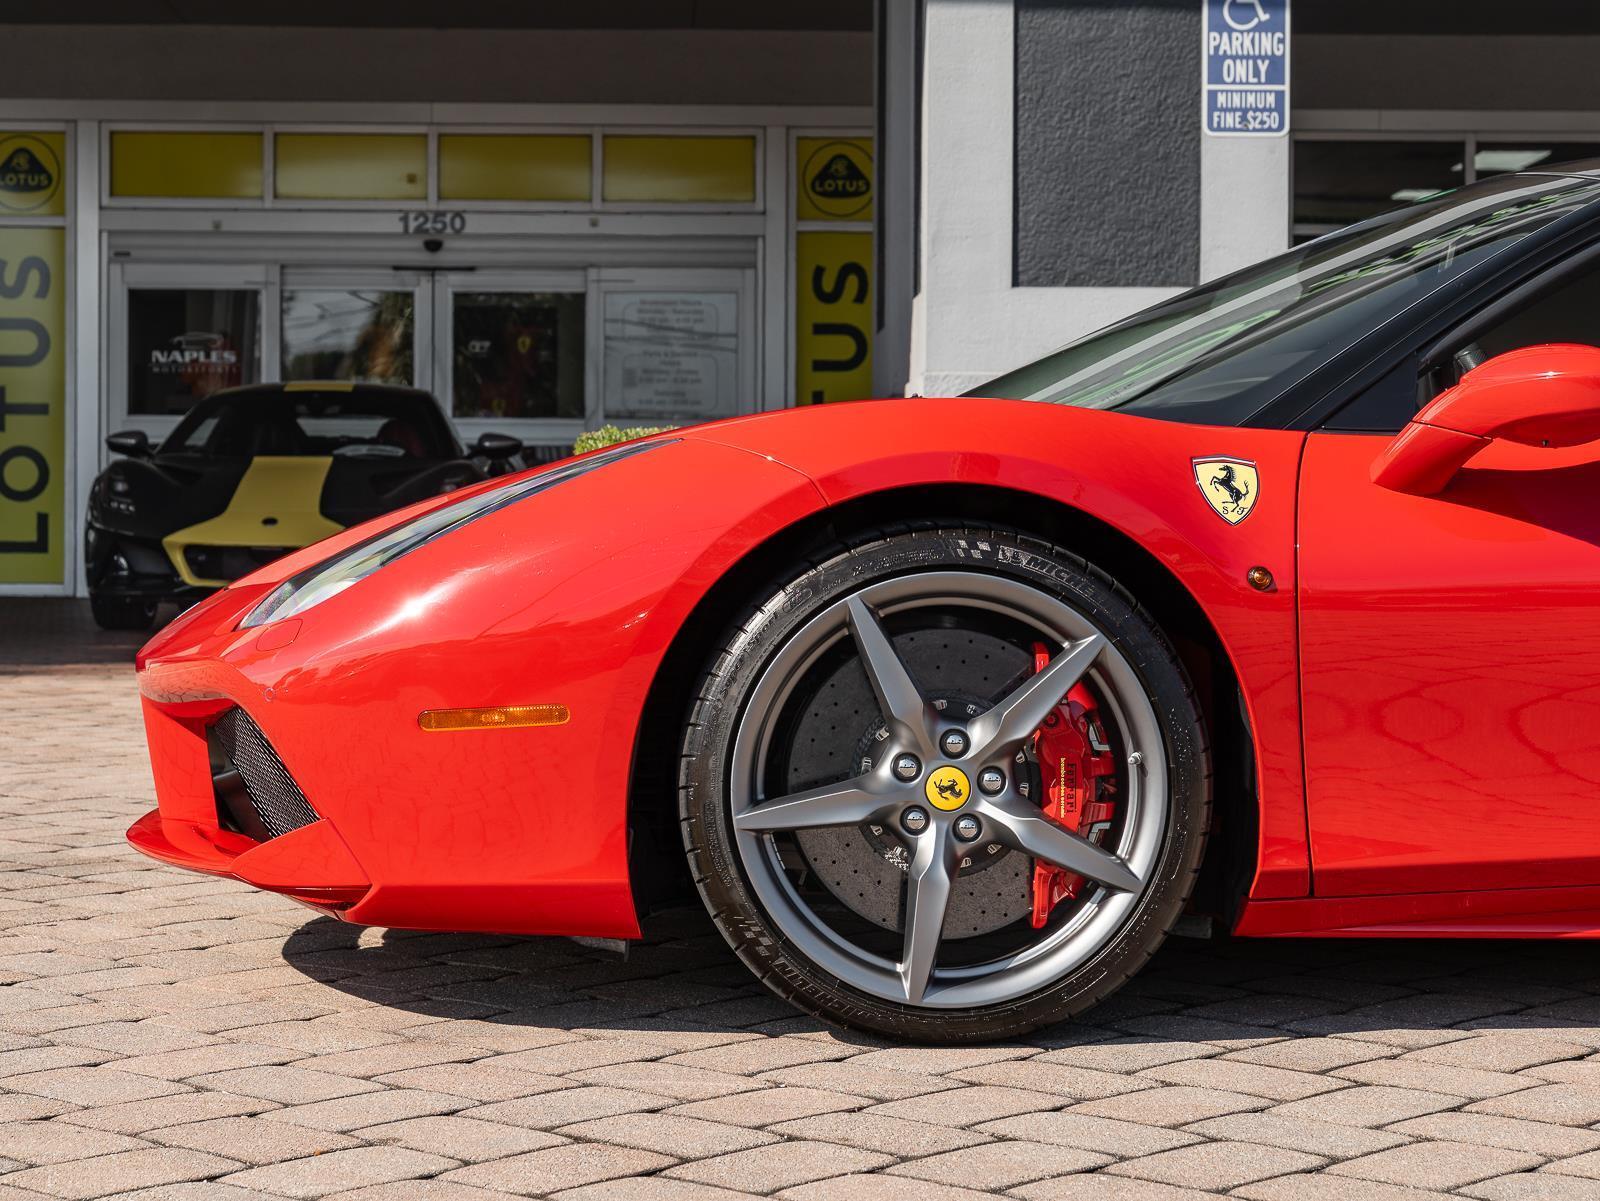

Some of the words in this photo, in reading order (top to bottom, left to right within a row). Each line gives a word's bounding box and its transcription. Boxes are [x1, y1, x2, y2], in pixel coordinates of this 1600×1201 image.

[1208, 31, 1285, 56] PARKING
[1222, 58, 1270, 83] ONLY
[1216, 91, 1276, 109] MINIMUM
[1212, 110, 1242, 129] FINE
[1246, 110, 1279, 130] $250
[815, 179, 867, 192] LOTUS
[398, 210, 466, 234] 1250
[812, 261, 868, 405] US
[151, 349, 237, 364] NAPLES
[0, 255, 51, 554] LOTUS
